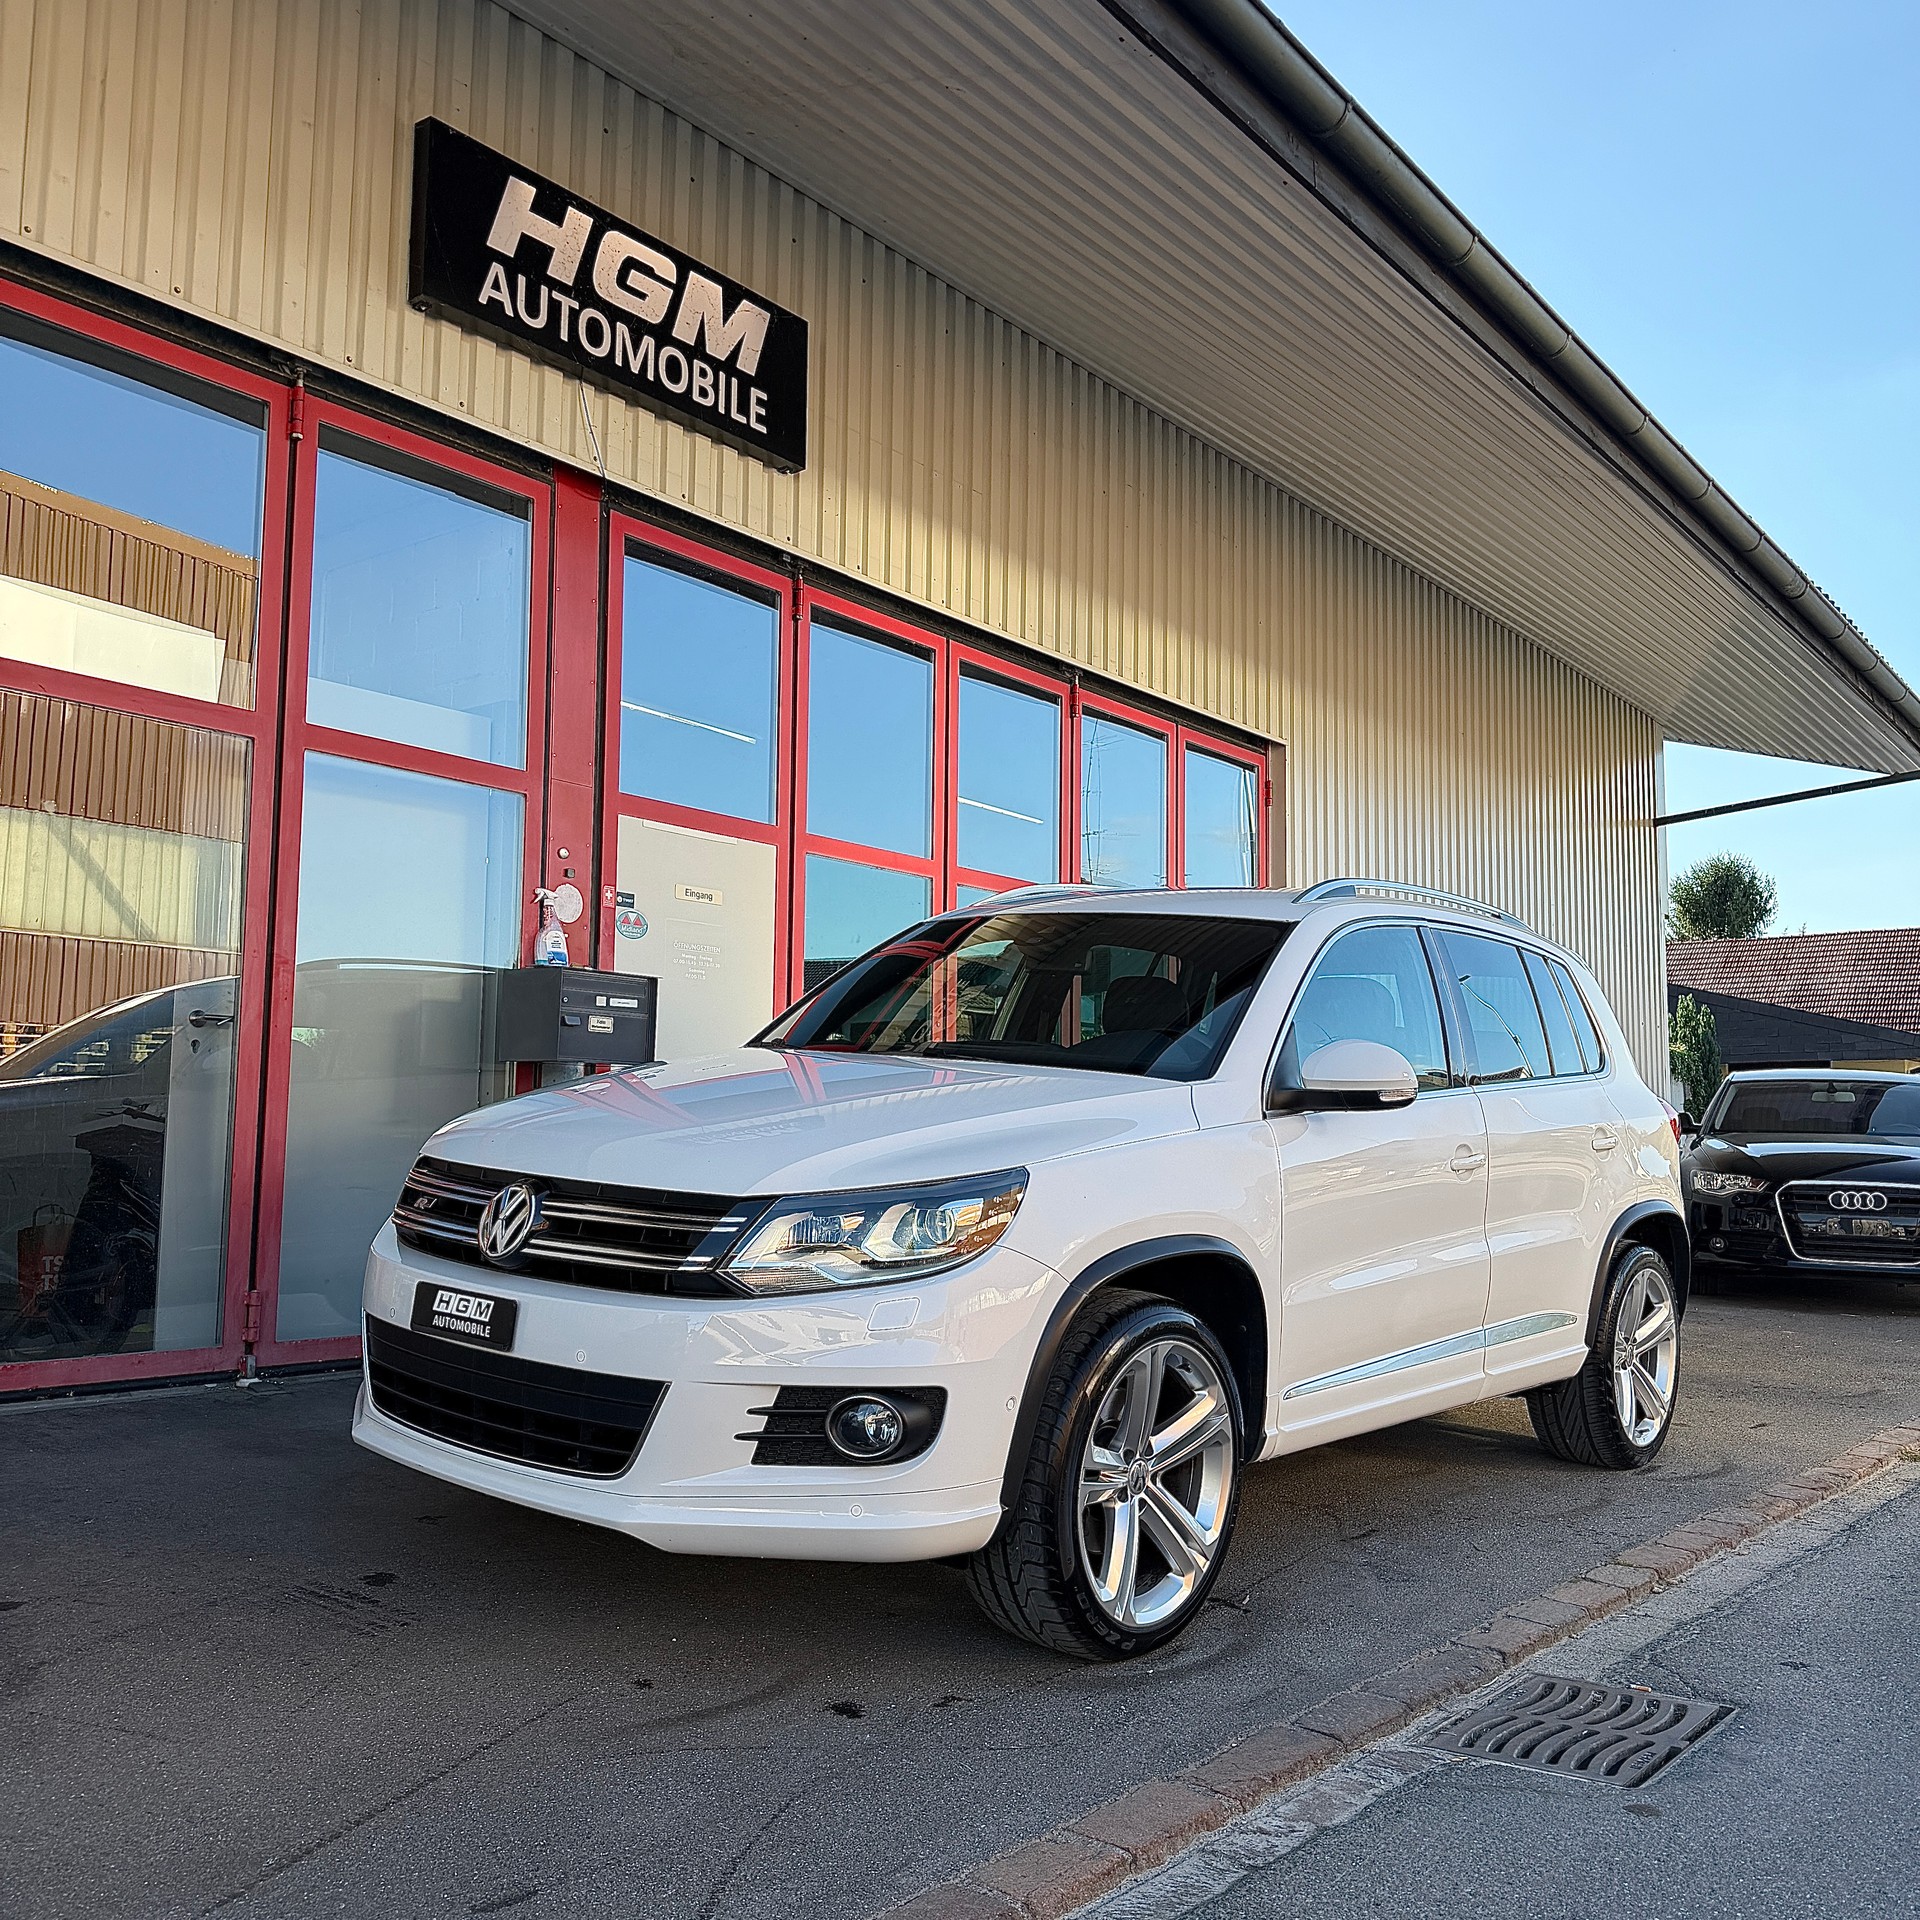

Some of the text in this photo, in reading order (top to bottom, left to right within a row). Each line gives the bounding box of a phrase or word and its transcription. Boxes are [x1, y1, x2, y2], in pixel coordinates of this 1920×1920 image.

[486, 174, 771, 377] HGM
[478, 262, 768, 434] AUTOMOBILE
[684, 887, 714, 902] Eingang
[432, 1289, 495, 1322] HGM
[432, 1314, 491, 1338] AUTOMOBILE
